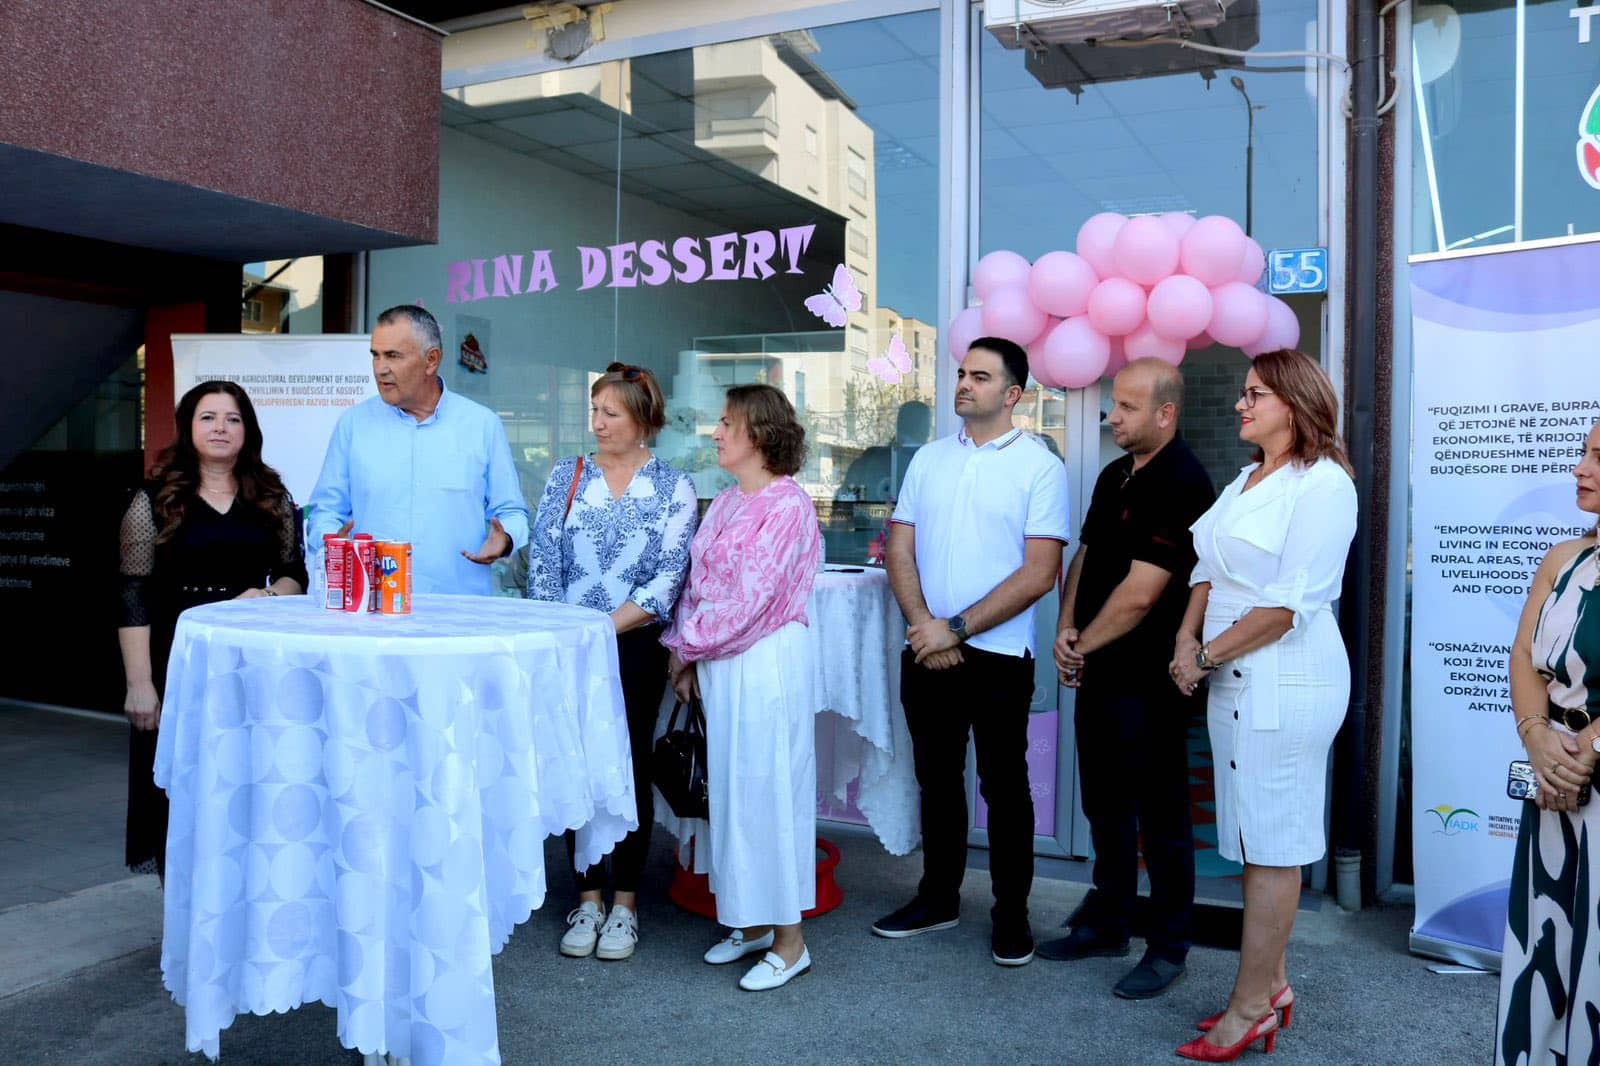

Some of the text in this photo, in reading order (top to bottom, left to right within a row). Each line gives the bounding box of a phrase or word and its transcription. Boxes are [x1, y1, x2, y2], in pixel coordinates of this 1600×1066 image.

[446, 224, 817, 304] RINA DESSERT
[1273, 252, 1322, 289] 55
[242, 375, 288, 384] AGRICULTURAL
[289, 375, 333, 384] DEVELOPMENT
[335, 375, 343, 384] OF
[345, 375, 370, 384] KOSOVO
[1501, 403, 1548, 414] GRAVE,
[1438, 420, 1456, 432] QË
[1459, 418, 1517, 430] JETOJNË
[1519, 416, 1536, 428] NË
[1540, 416, 1588, 427] ZONAT
[1432, 434, 1514, 446] EKONOMIKE,
[1517, 432, 1533, 443] TË
[1434, 448, 1535, 462] QËNDRUESHME
[1430, 463, 1507, 476] BUJQËSORE
[1511, 464, 1538, 474] DHE
[1439, 540, 1481, 550] LIVING
[1485, 540, 1498, 549] IN
[1431, 554, 1473, 564] RURAL
[1476, 555, 1524, 566] AREAS,
[1441, 569, 1529, 580] LIVELIHOODS
[1452, 584, 1481, 594] AND
[1485, 585, 1523, 595] FOOD
[1443, 657, 1505, 669] KOJI ŽIVE
[1450, 672, 1508, 684] EKONOM
[1443, 686, 1497, 698] ODRŽIVI
[1450, 820, 1480, 832] IADK
